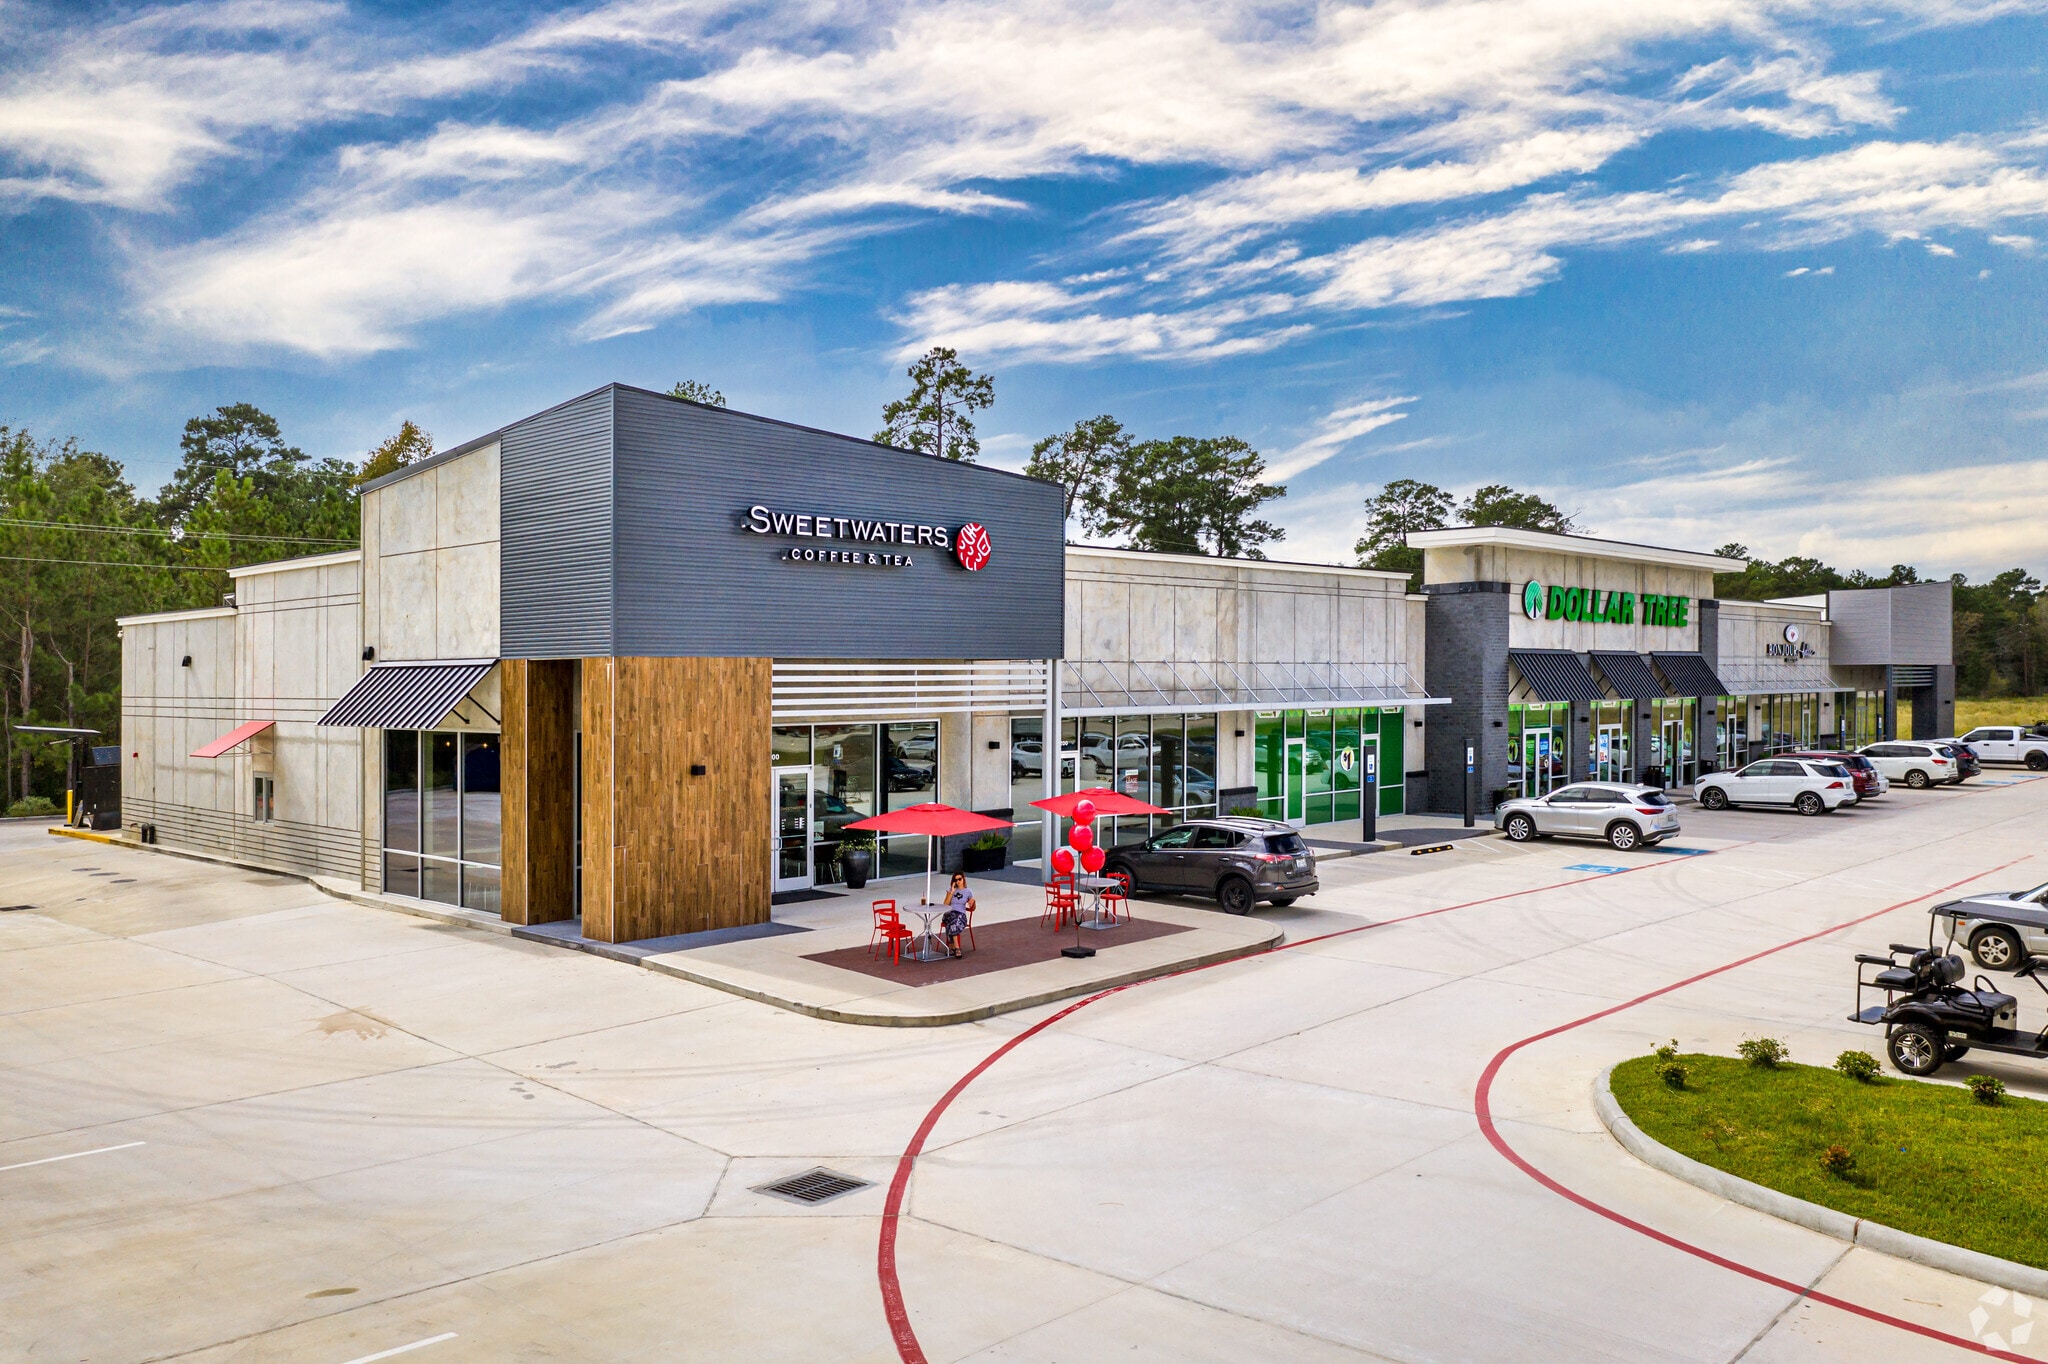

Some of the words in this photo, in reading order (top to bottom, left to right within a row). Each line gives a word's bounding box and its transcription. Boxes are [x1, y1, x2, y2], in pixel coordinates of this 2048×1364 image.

[749, 505, 948, 547] SWEETWATERS
[791, 548, 860, 564] COFFEE
[868, 553, 877, 565] &
[883, 554, 913, 567] TEA
[1547, 585, 1636, 625] DOLLAR
[1642, 593, 1690, 627] TREE
[1767, 643, 1798, 656] BONJOUR
